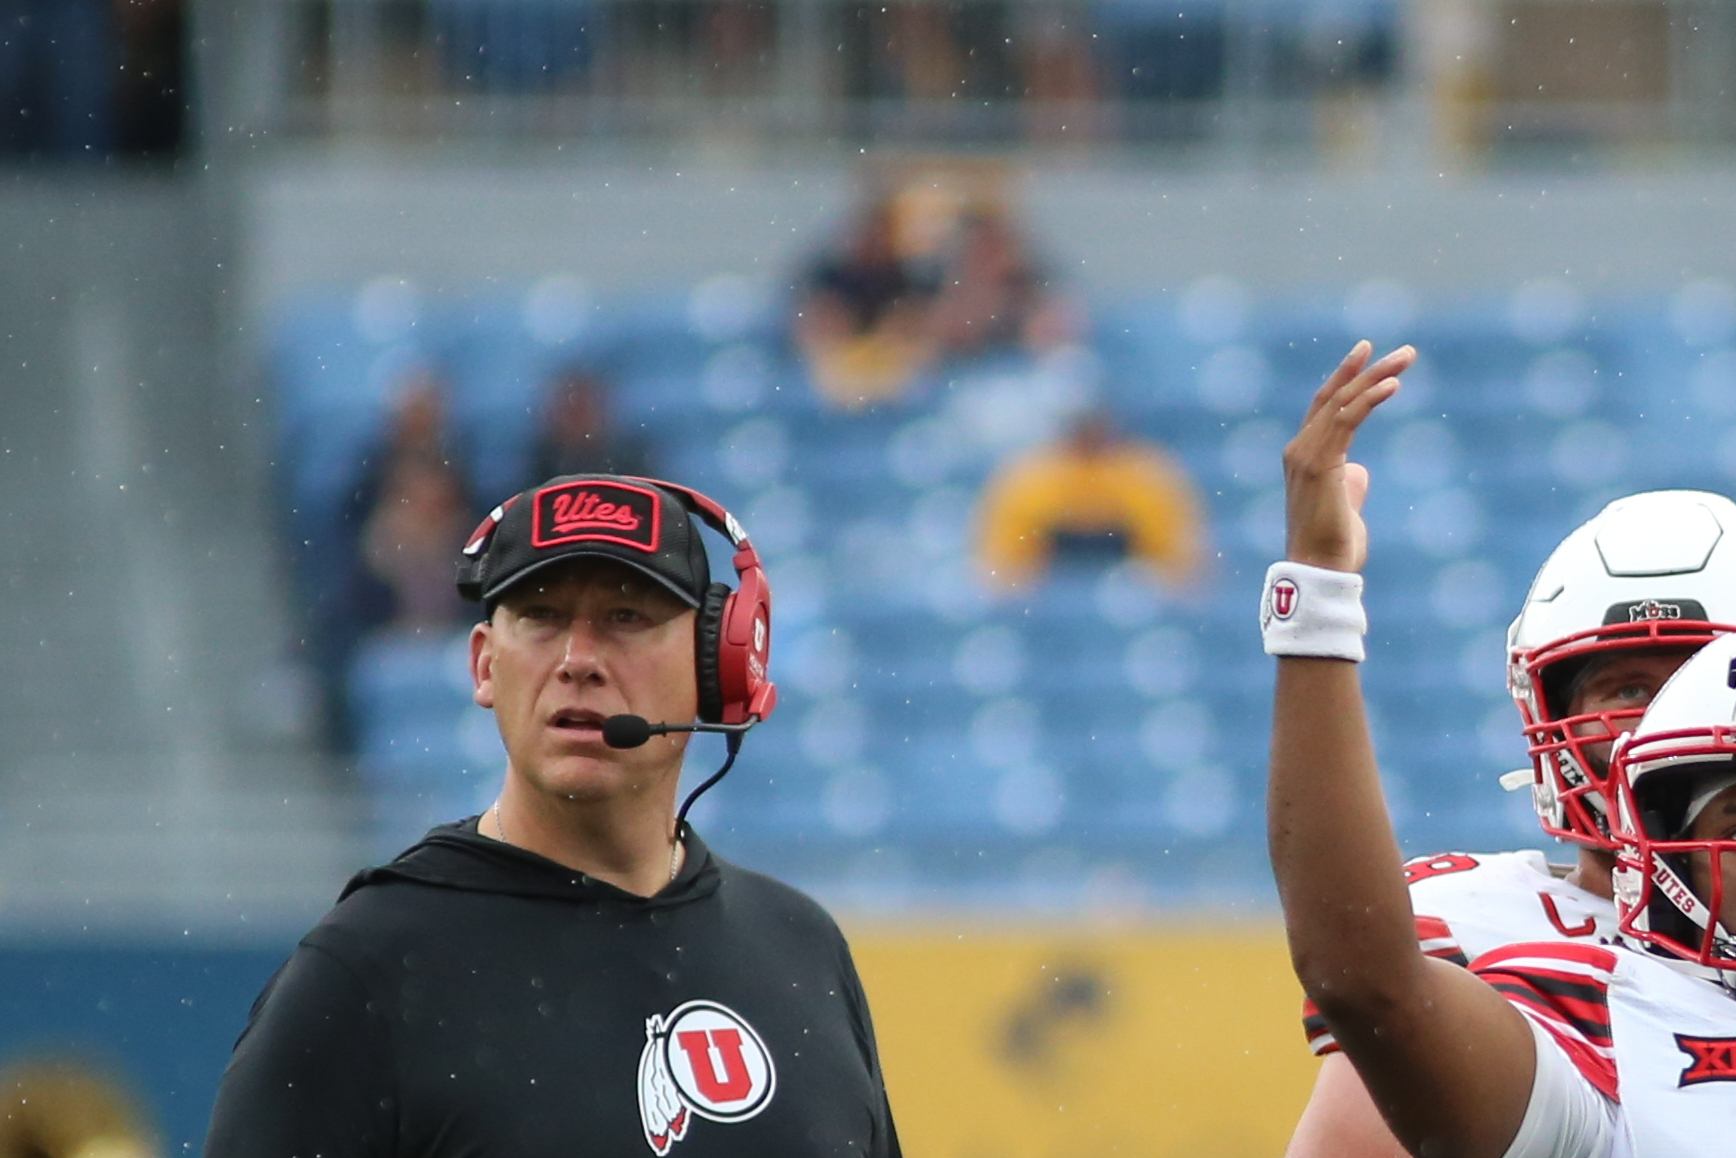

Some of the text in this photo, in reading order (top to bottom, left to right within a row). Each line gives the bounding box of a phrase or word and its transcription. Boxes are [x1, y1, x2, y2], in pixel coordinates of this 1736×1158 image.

[552, 491, 639, 531] Utes
[1275, 587, 1295, 615] U
[1656, 867, 1696, 914] UTES
[676, 1028, 753, 1104] U
